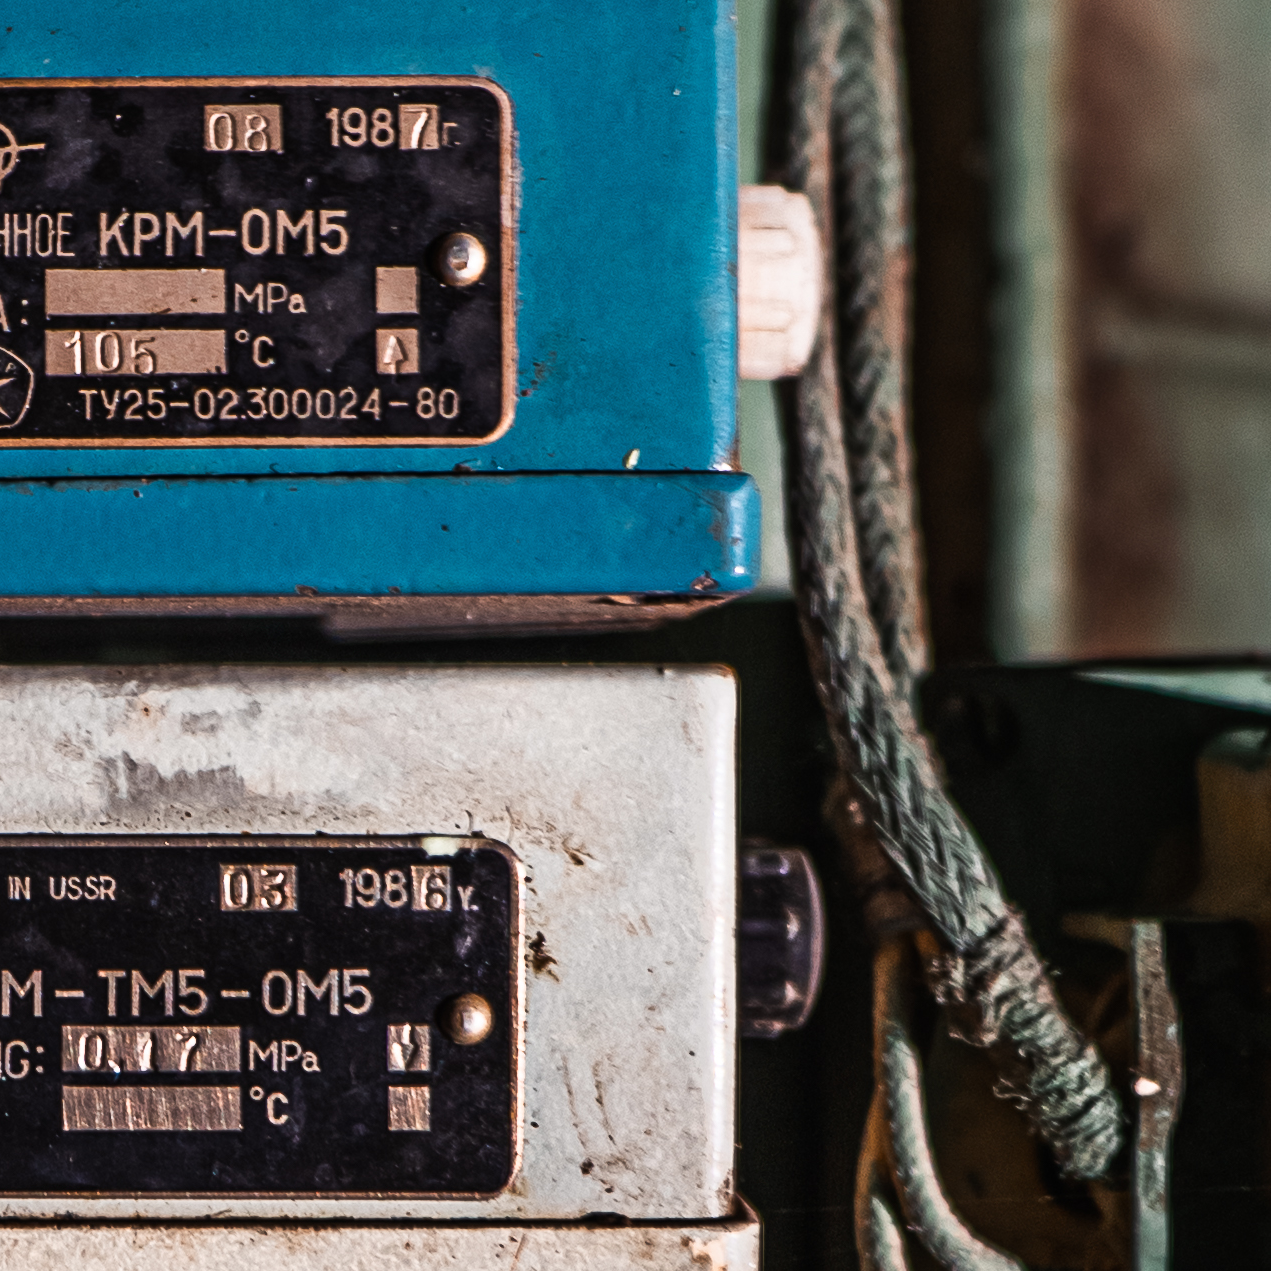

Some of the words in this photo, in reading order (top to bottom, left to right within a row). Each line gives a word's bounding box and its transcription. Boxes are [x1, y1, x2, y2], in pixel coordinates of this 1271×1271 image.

[208, 112, 268, 151] 08
[234, 282, 307, 314] MPa
[64, 330, 157, 376] 105
[7, 876, 31, 900] IN
[49, 875, 117, 900] USSR
[223, 867, 286, 909] 03
[247, 1041, 321, 1072] MPa
